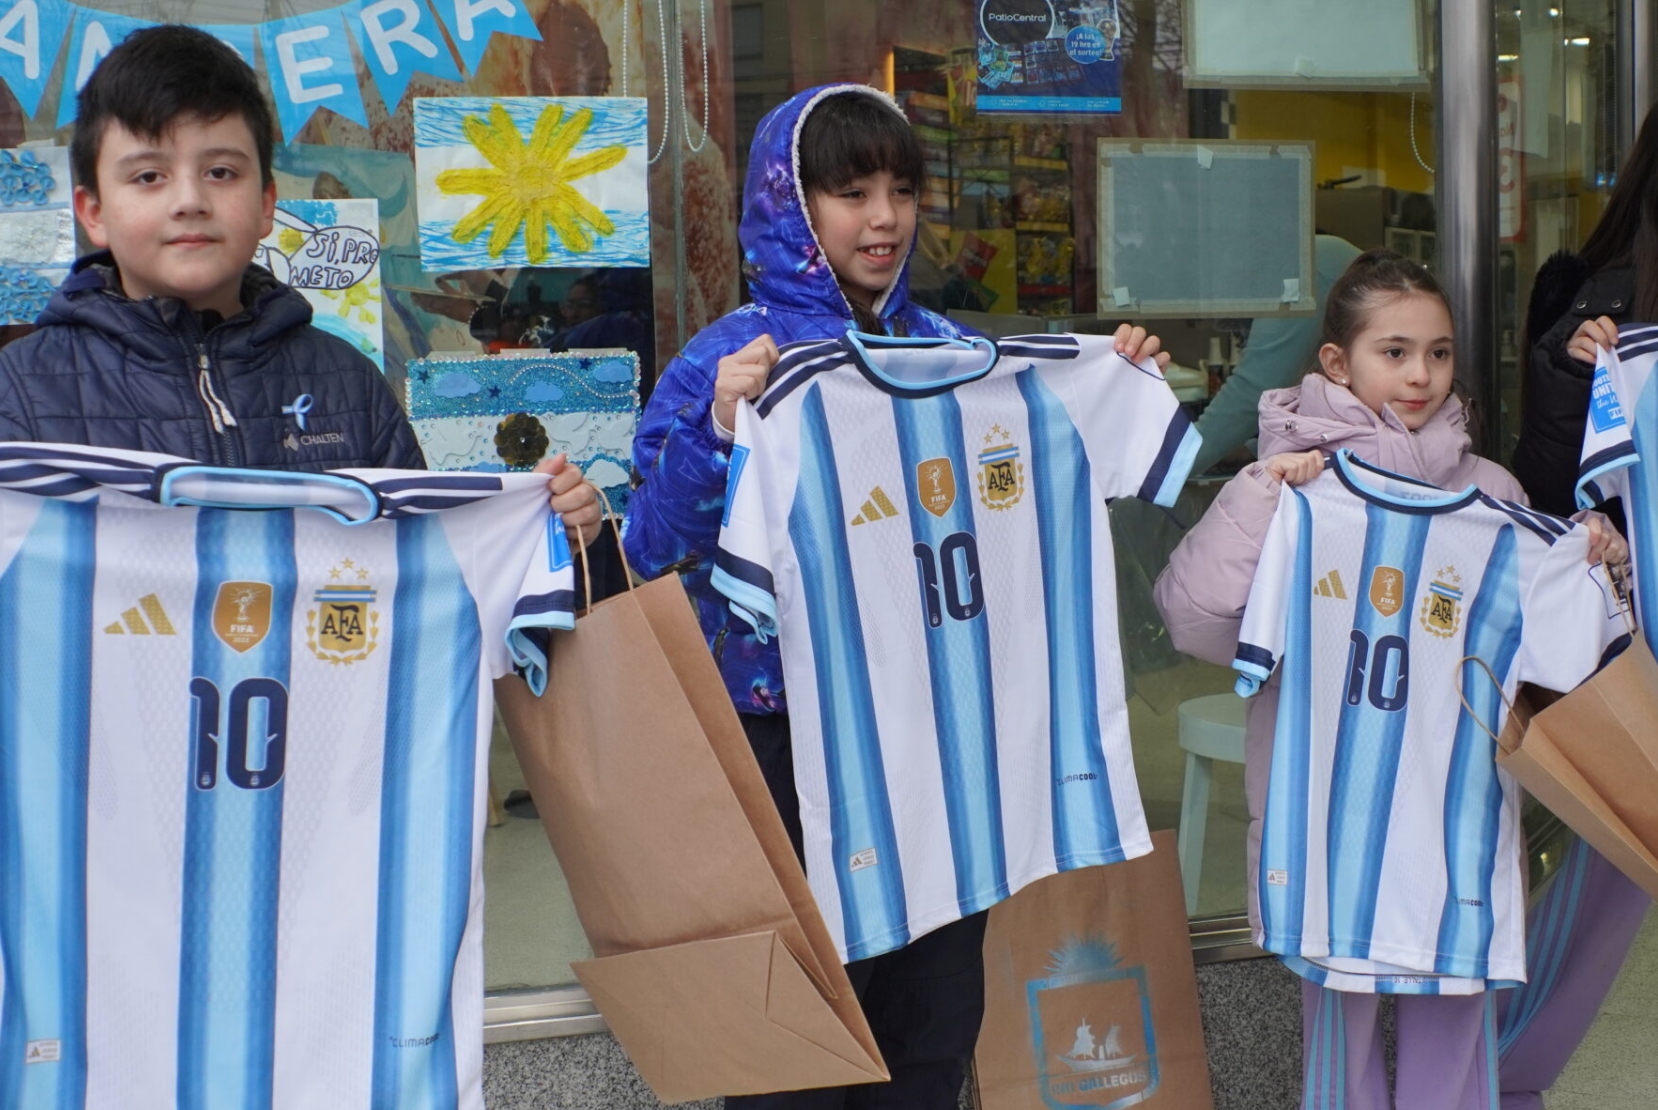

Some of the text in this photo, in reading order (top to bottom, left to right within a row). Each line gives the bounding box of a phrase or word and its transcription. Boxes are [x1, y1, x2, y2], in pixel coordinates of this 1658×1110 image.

[988, 12, 1047, 22] PatioCentral
[300, 432, 345, 446] CHALTEN
[988, 461, 1015, 492] AFA
[931, 494, 947, 503] FIFA
[912, 530, 985, 630] 10
[1380, 596, 1396, 605] FIFA
[1431, 595, 1453, 624] AFA
[230, 624, 254, 633] FIFA
[320, 603, 364, 643] AFA
[1346, 628, 1411, 713] 10
[188, 676, 289, 791] 10
